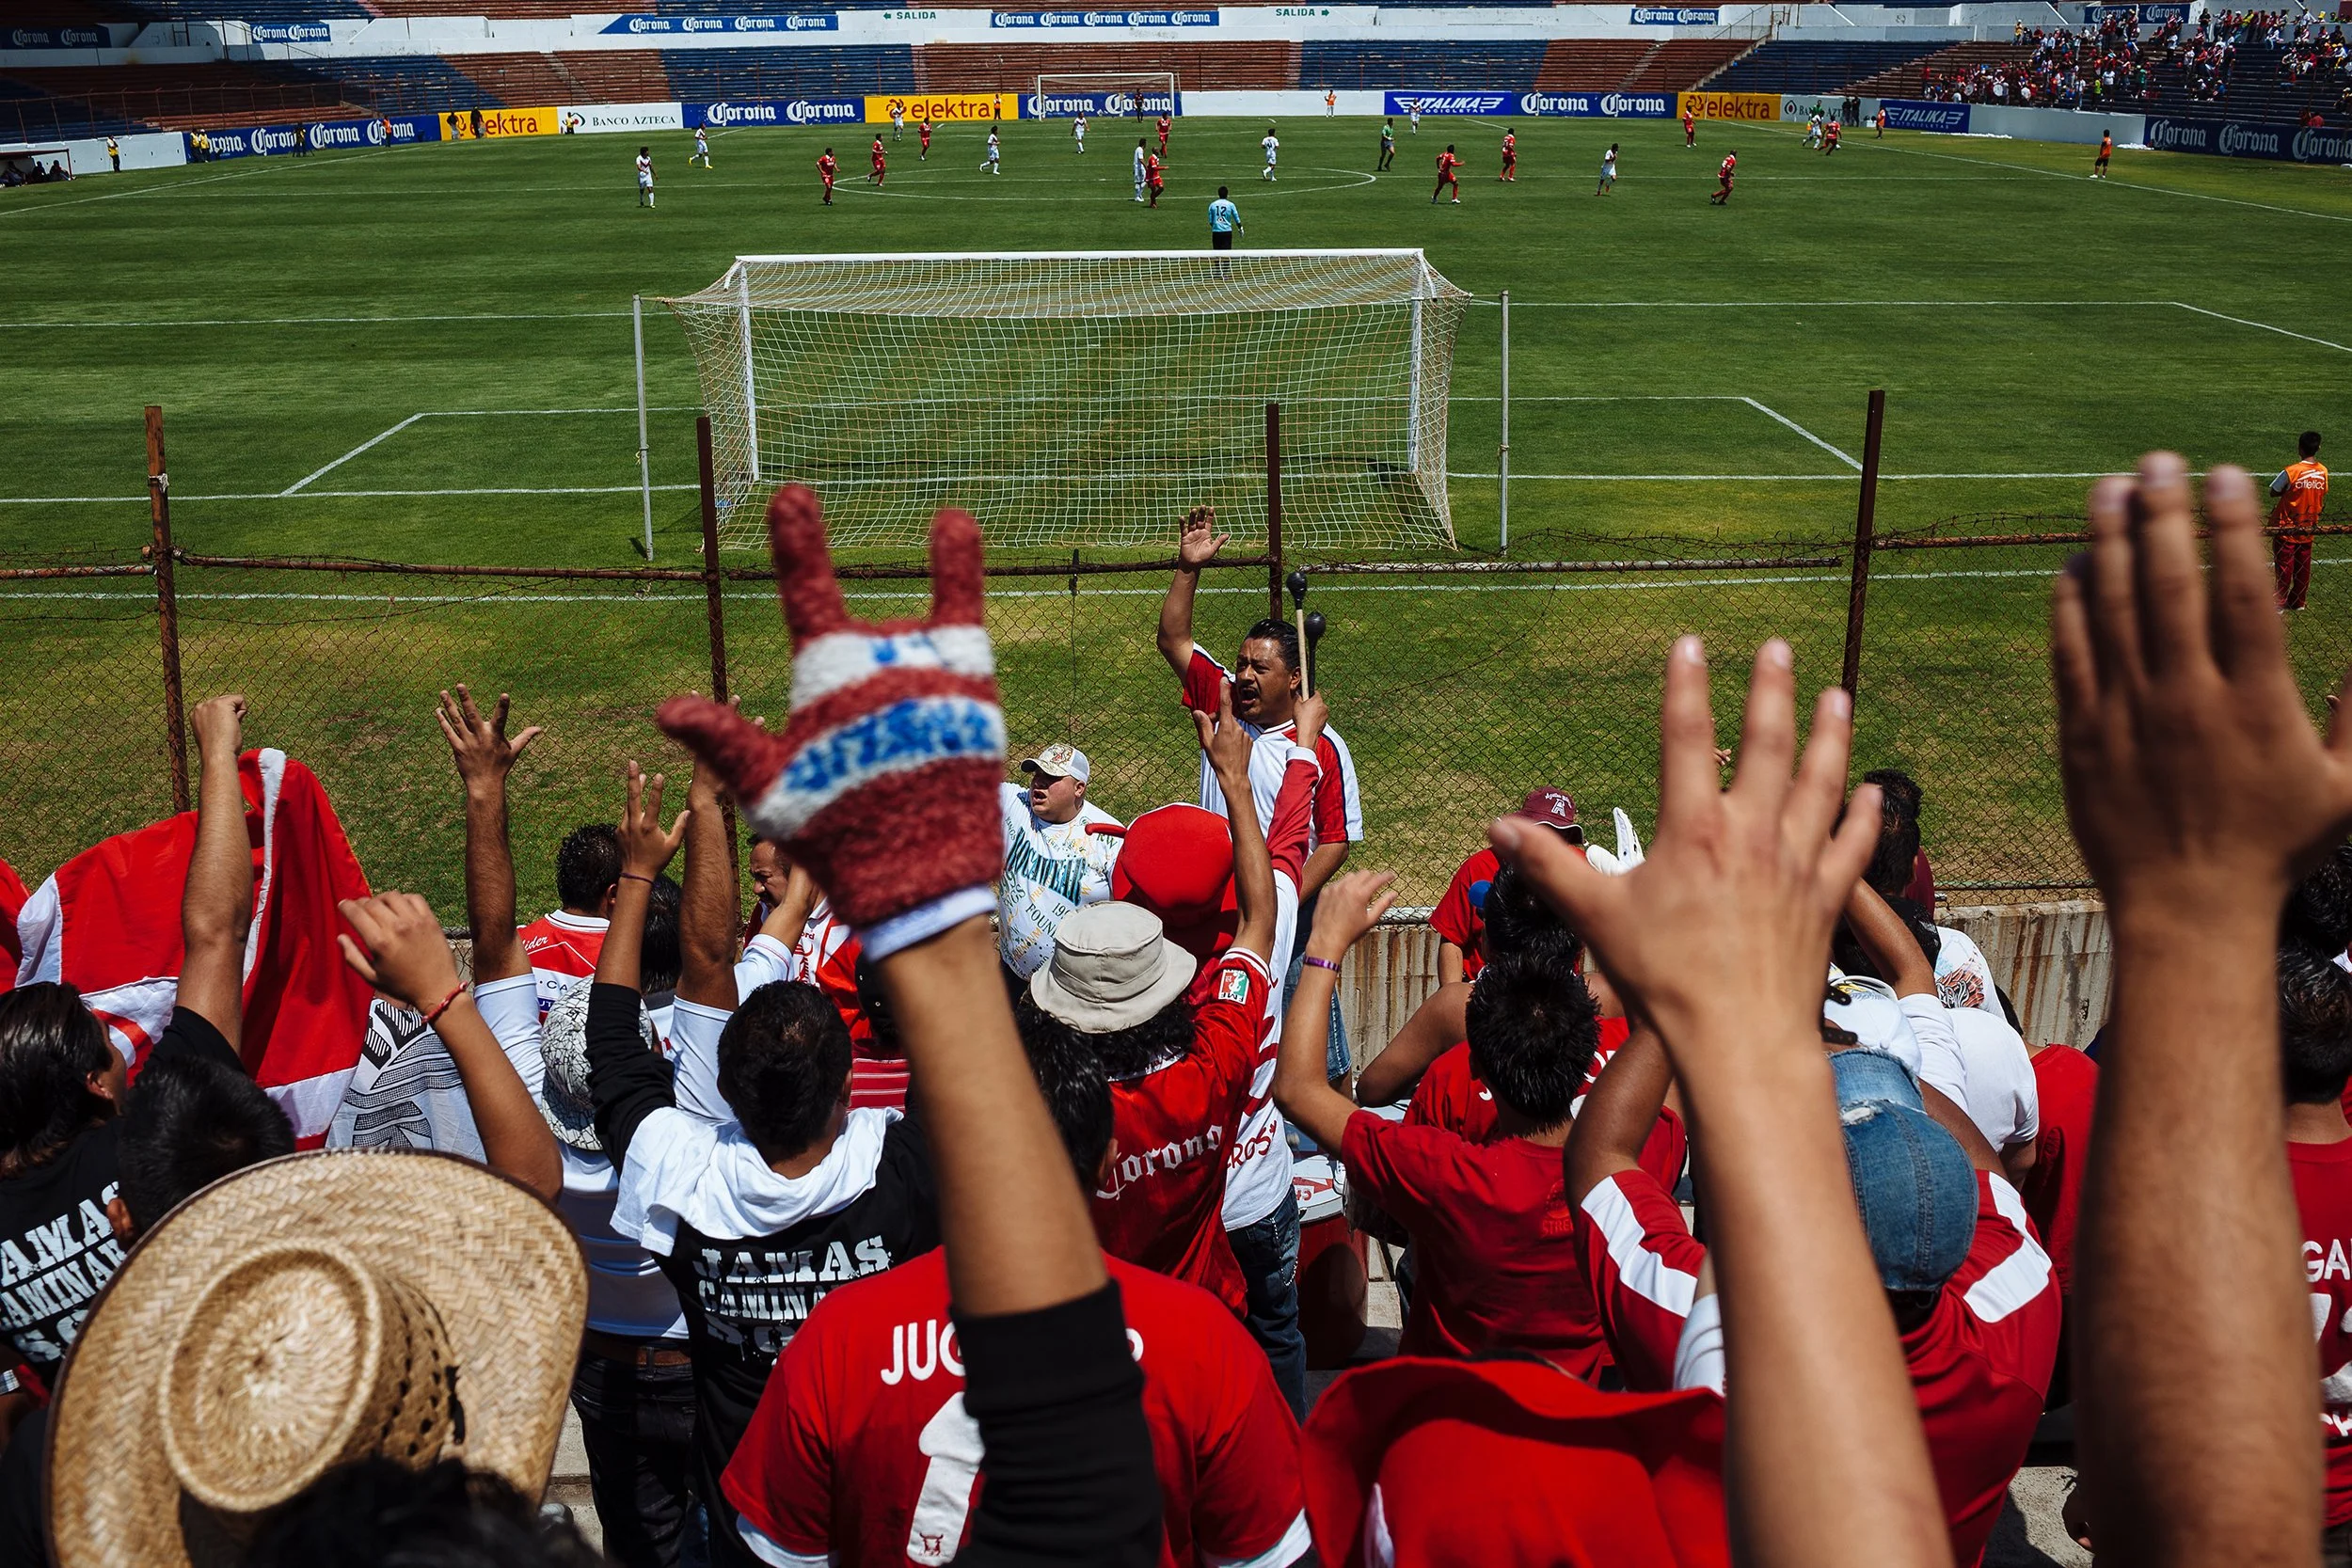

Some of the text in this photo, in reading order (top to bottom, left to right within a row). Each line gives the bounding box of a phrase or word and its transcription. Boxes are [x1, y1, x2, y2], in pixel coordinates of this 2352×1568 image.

[628, 15, 826, 32] Corona Corona Corona Corona
[897, 11, 936, 20] SALIDA
[994, 10, 1211, 26] Corona Corona Corona Corona Corona
[1634, 8, 1674, 24] Corona
[12, 28, 98, 46] Corona Corona
[252, 24, 328, 40] Corona Corona
[707, 100, 855, 126] Corona Corona
[912, 98, 991, 119] elektra
[1105, 93, 1172, 117] Coona
[1521, 91, 1665, 117] Corona Corona
[592, 115, 676, 126] BANCO AZTECA
[310, 123, 360, 149] Corona
[2151, 119, 2206, 148] Corona
[2219, 124, 2279, 155] Corona
[1216, 206, 1227, 216] 12
[692, 1235, 893, 1284] JAMAS
